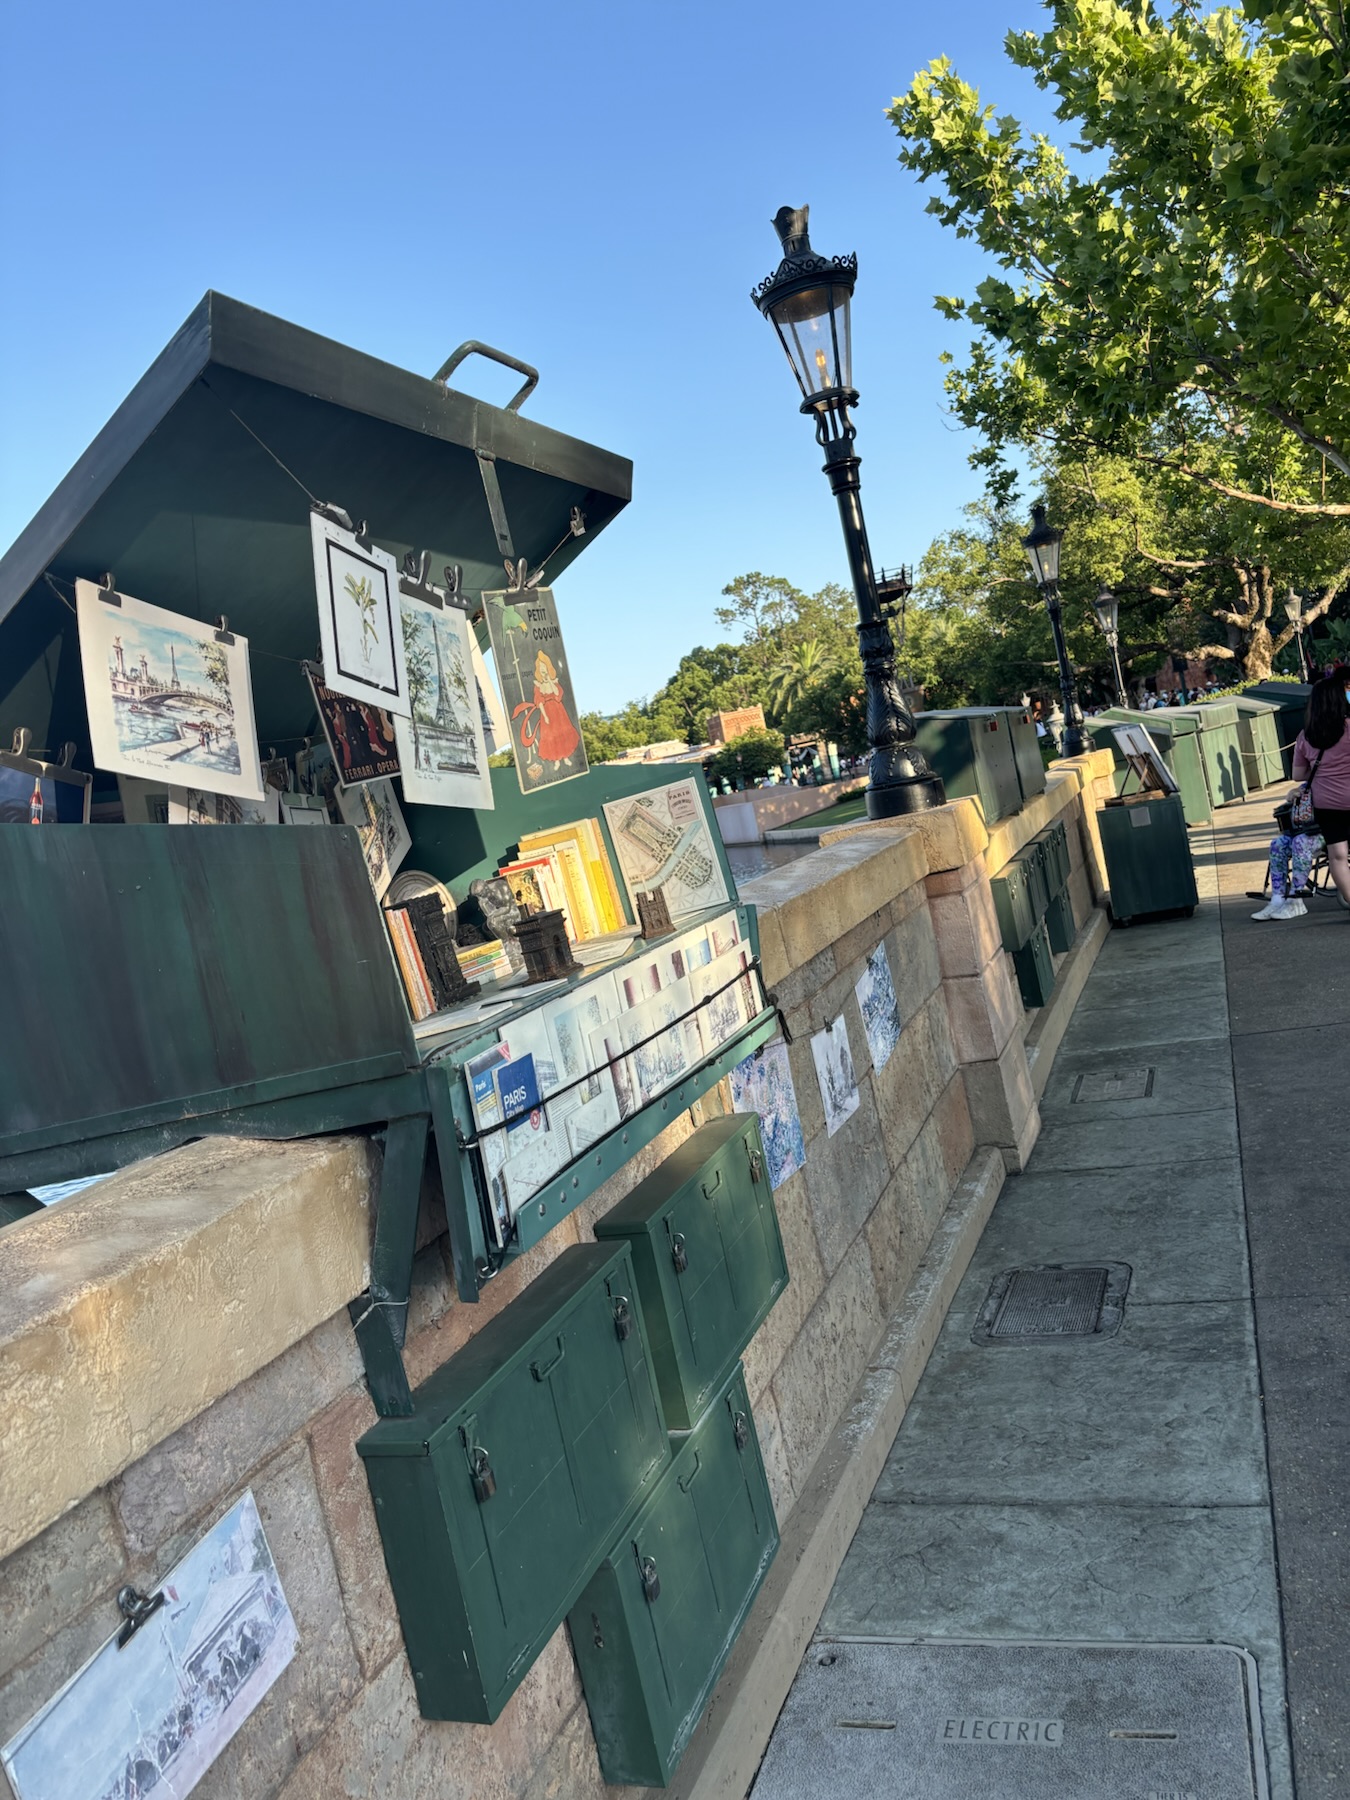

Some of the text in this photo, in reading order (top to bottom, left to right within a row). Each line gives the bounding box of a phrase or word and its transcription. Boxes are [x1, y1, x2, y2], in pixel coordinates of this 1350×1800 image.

[527, 605, 547, 622] PETIT
[532, 622, 560, 641] COQUIN
[503, 1085, 527, 1110] PARIS
[943, 1719, 1058, 1742] ELECTRIC
